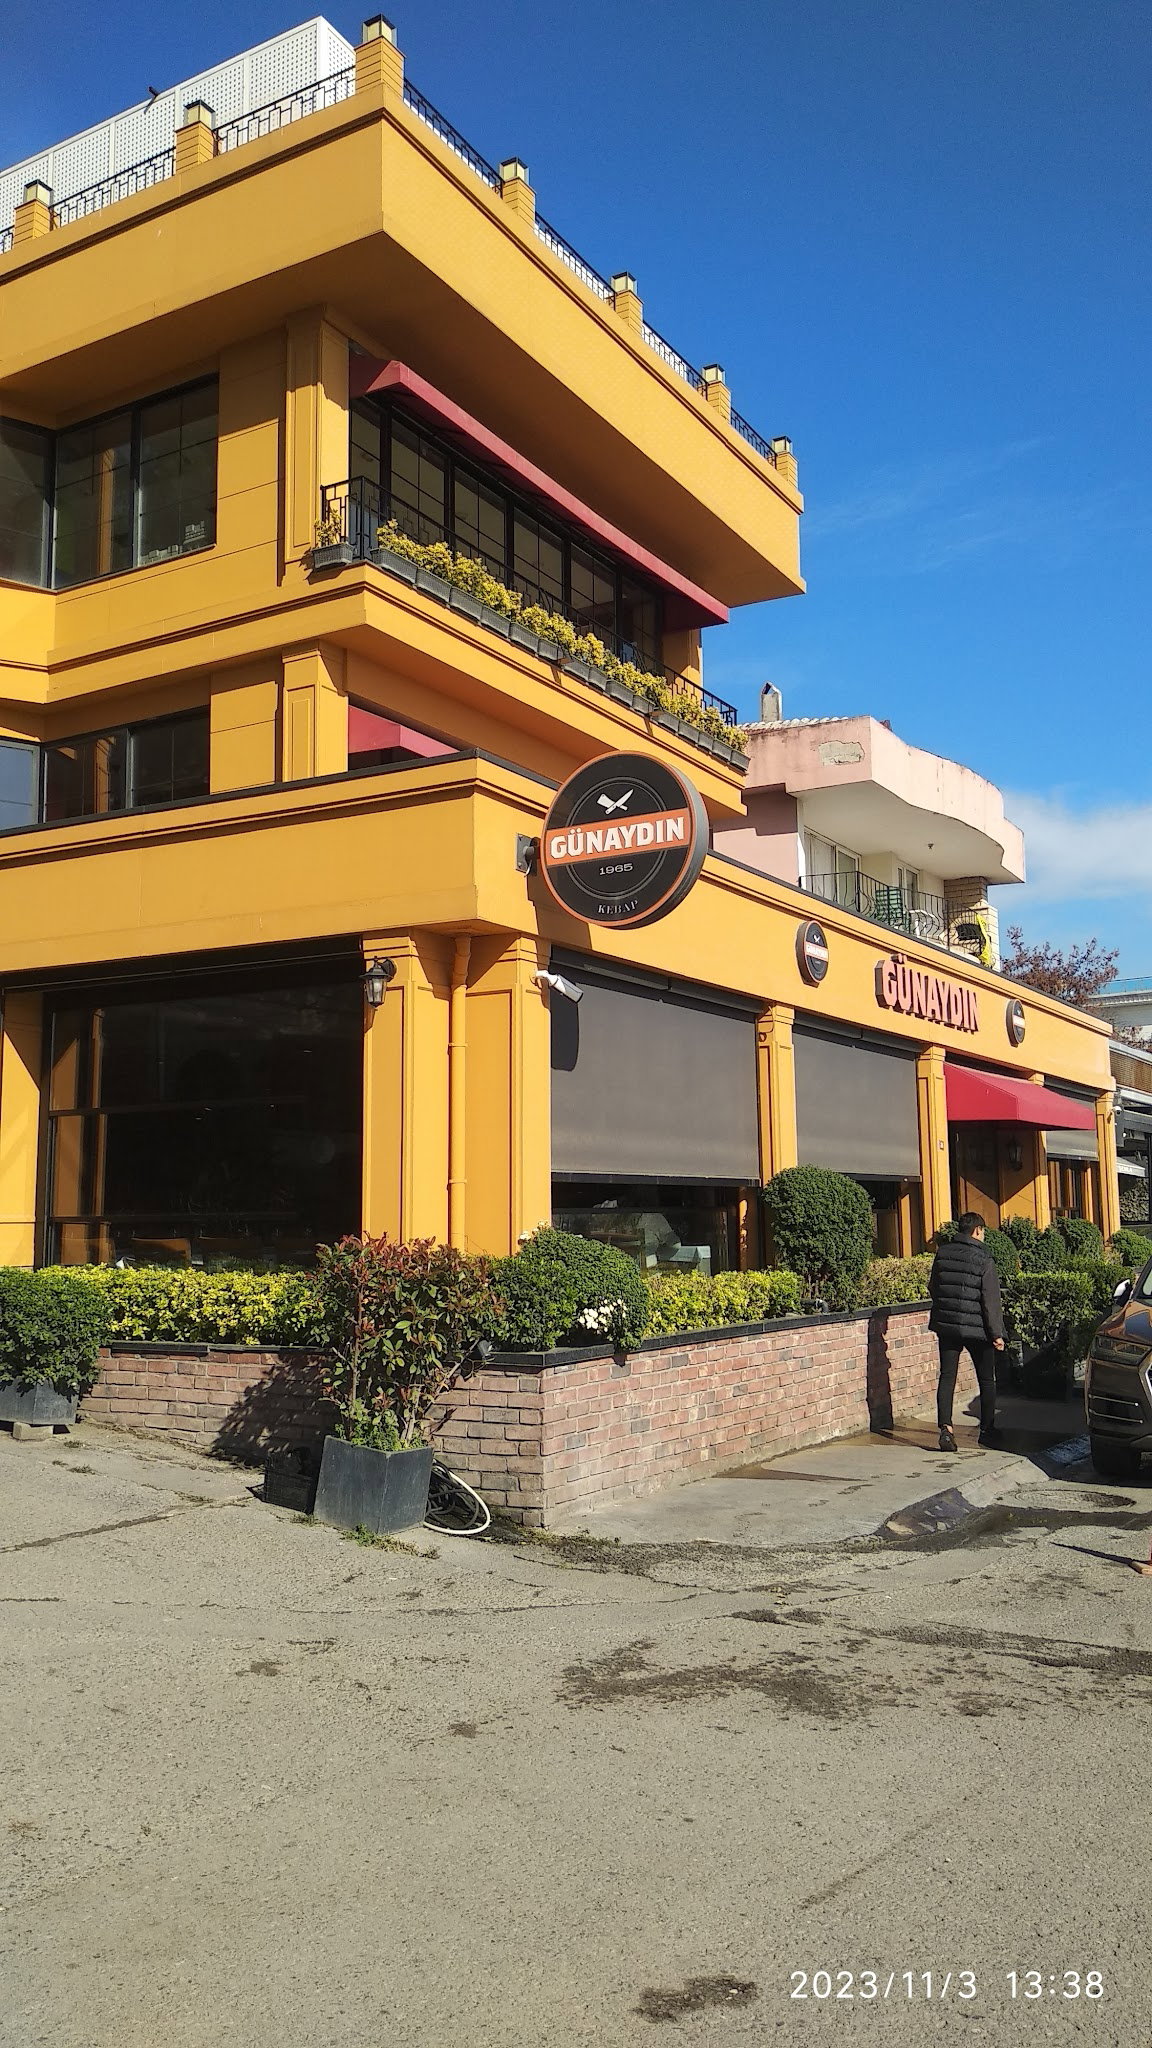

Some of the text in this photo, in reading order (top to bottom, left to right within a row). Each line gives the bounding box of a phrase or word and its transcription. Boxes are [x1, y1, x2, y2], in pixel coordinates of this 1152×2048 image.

[550, 816, 685, 859] GÜNAYDIN
[599, 862, 634, 876] 1965
[597, 899, 639, 915] KEBAP
[876, 953, 979, 1033] GÜNAYDIN
